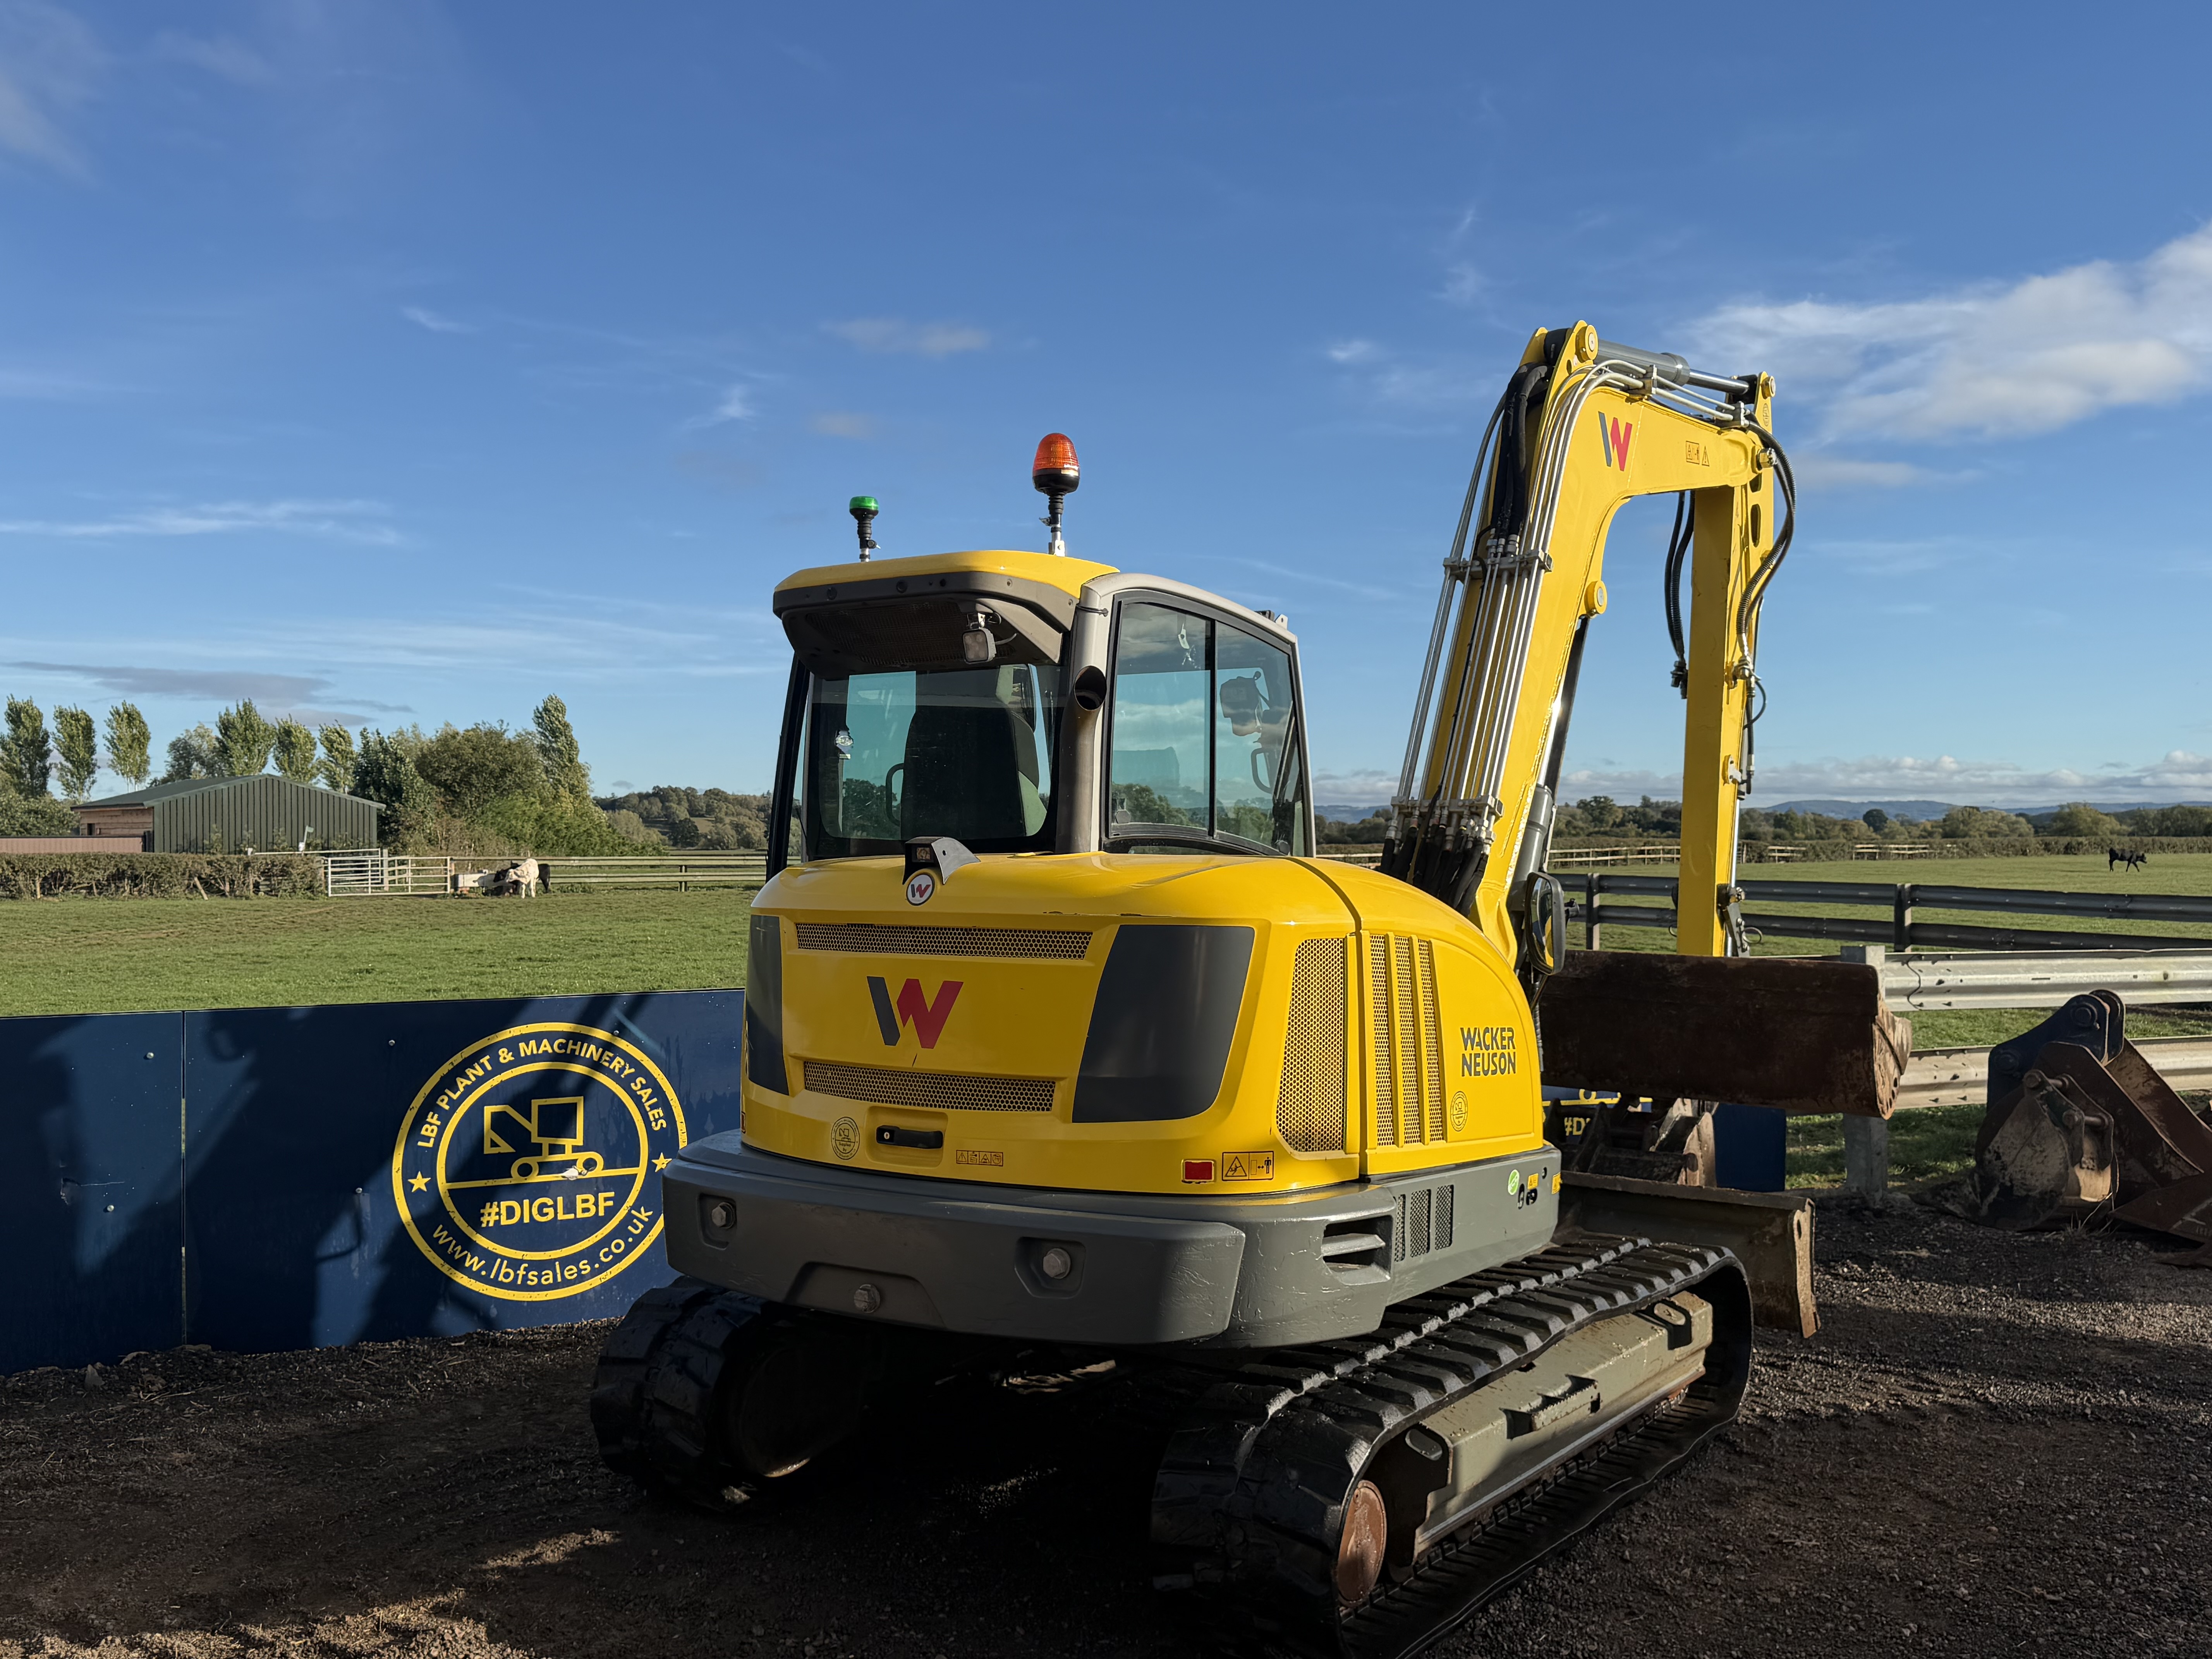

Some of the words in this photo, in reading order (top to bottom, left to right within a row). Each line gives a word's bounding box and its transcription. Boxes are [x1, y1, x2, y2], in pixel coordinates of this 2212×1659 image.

[1460, 1027, 1516, 1051] WACKER
[1461, 1051, 1516, 1077] NEUSON
[417, 1111, 441, 1147] LBF
[436, 1055, 492, 1110] PLANT
[498, 1048, 515, 1063] &
[519, 1039, 635, 1078] MACHINERY
[630, 1077, 667, 1131] SALES
[480, 1192, 615, 1227] #DIGLBF
[433, 1206, 654, 1285] www.lbfsales.co.uk
